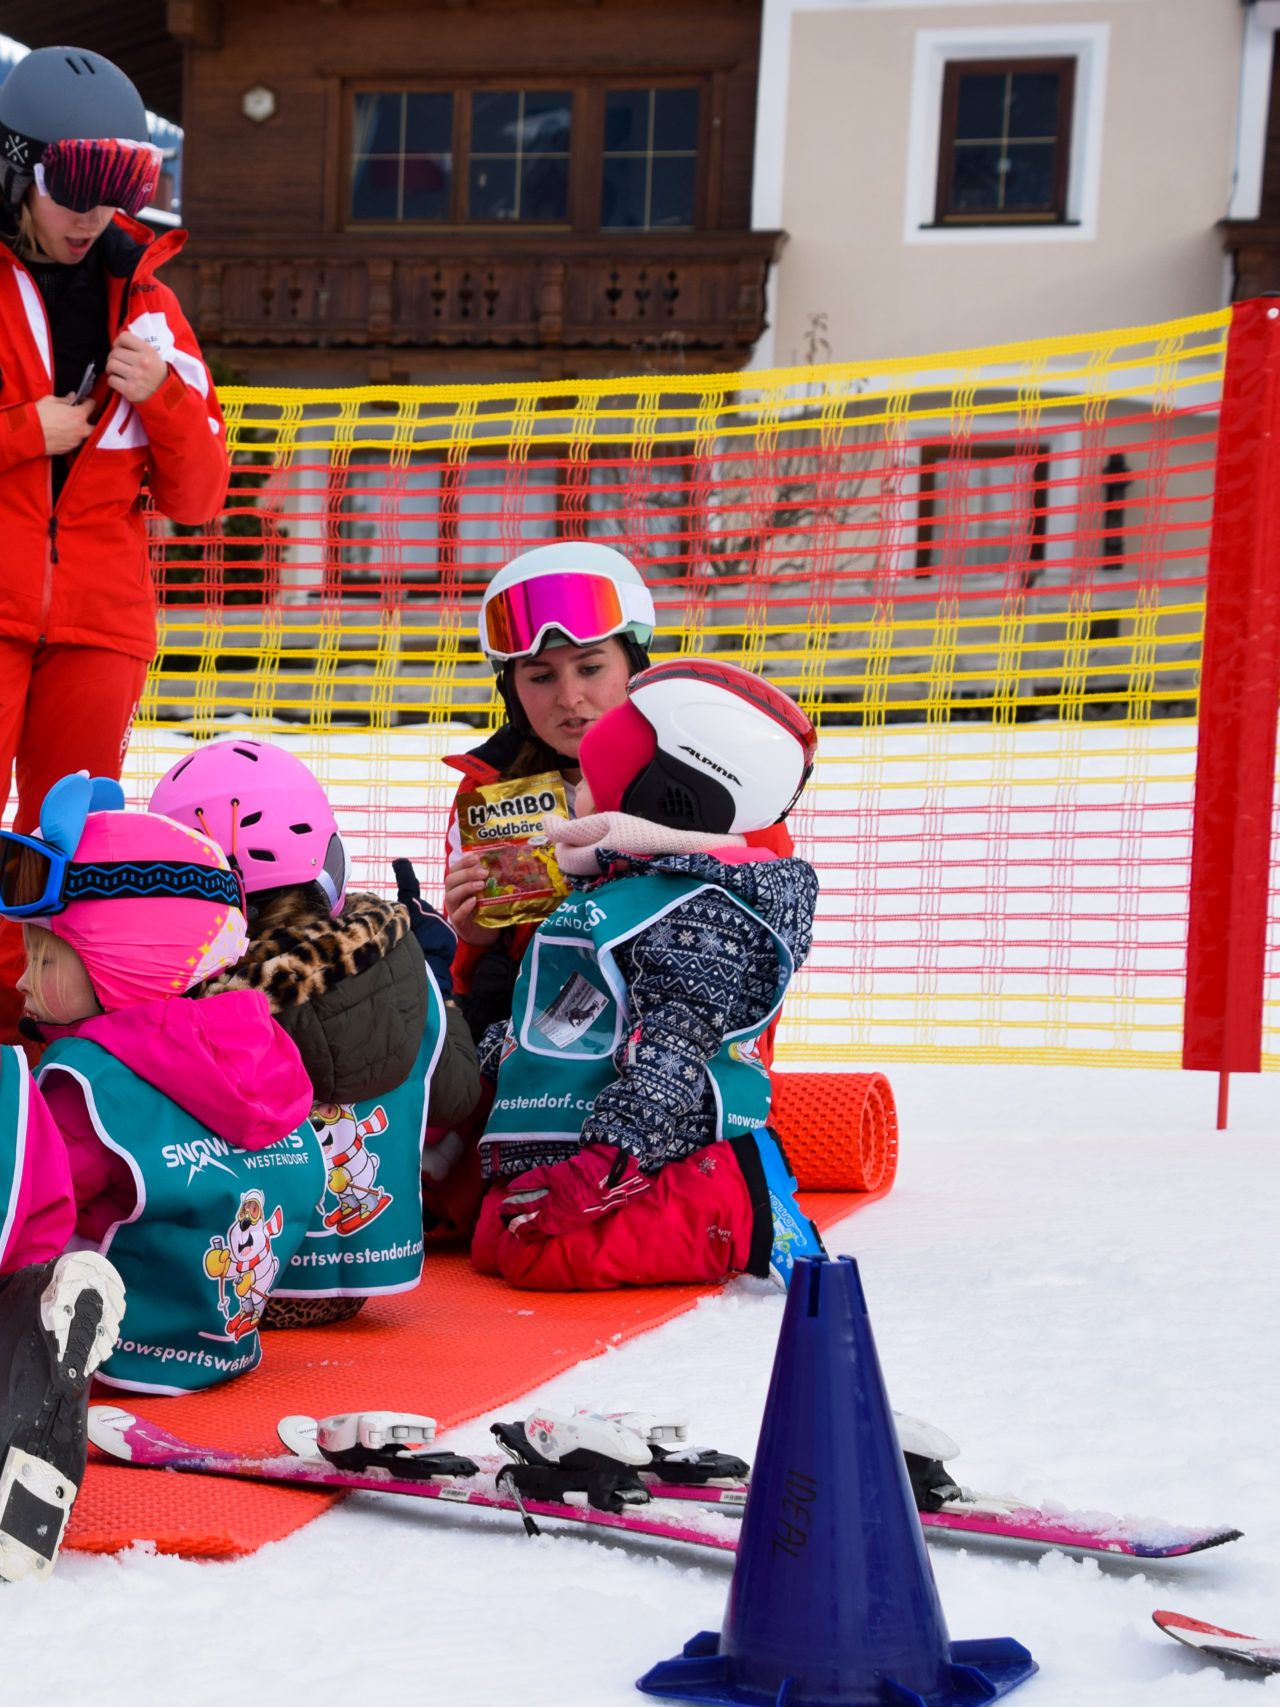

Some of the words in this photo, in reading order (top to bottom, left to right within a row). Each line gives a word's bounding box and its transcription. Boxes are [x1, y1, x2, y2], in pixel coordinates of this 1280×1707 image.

[677, 744, 743, 787] ALPINA
[469, 792, 556, 826] HARIBO
[243, 1152, 309, 1170] WESTENDORF
[770, 1469, 818, 1558] IDEAL
